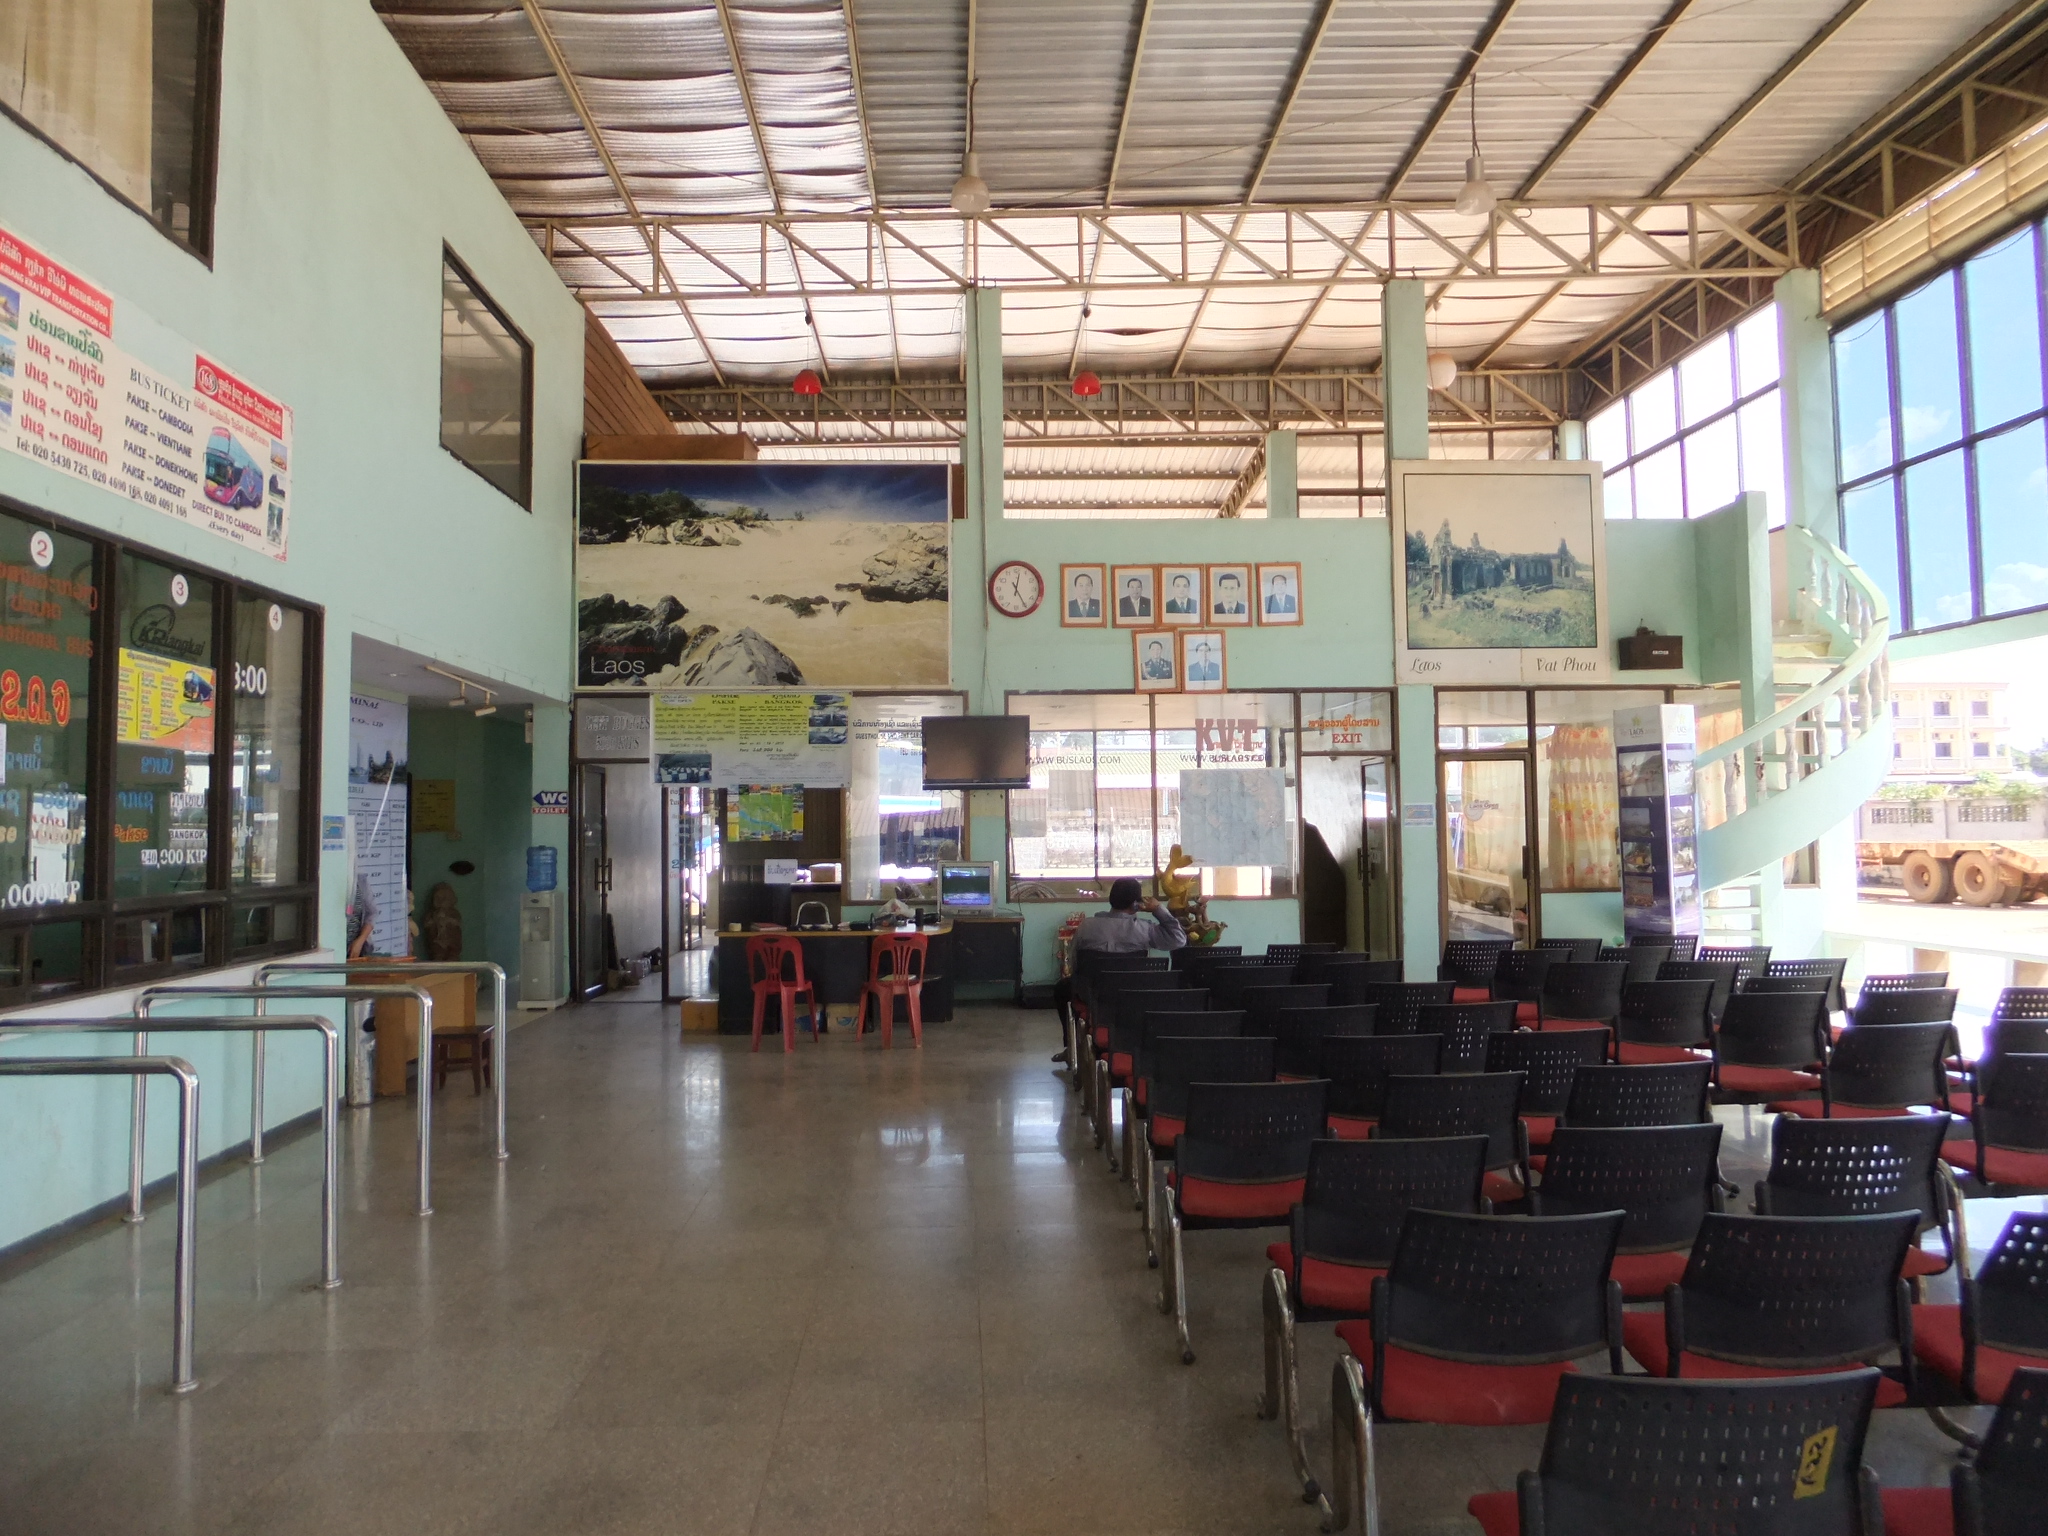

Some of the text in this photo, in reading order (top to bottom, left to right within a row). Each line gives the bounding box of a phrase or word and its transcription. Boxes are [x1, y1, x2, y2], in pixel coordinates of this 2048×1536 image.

[39, 283, 52, 299] VIP
[52, 292, 99, 328] TRANSPORTATION
[130, 368, 151, 391] BUS
[152, 380, 192, 413] TICKET
[126, 391, 150, 414] PAKSE
[158, 408, 195, 438] CAMBODIA
[125, 415, 193, 459] PAKSE VIENTIANE
[16, 437, 30, 451] Tel:
[32, 446, 49, 461] 020
[51, 451, 72, 470] 5430
[73, 461, 91, 479] 725,
[92, 468, 107, 485] 020
[123, 439, 199, 484] PAKSE DONEKHONG
[122, 462, 186, 500] PAKSE DONEDET
[192, 499, 262, 538] DIRECT BUS TO CAMBODIA
[37, 539, 48, 558] 2
[176, 581, 185, 597] 3
[591, 655, 645, 674] Laos
[1410, 657, 1597, 675] Laos Vat Phou
[1195, 719, 1258, 752] KVT
[1332, 734, 1362, 743] EXIT
[541, 793, 568, 804] WC
[170, 829, 206, 839] BANGKOK
